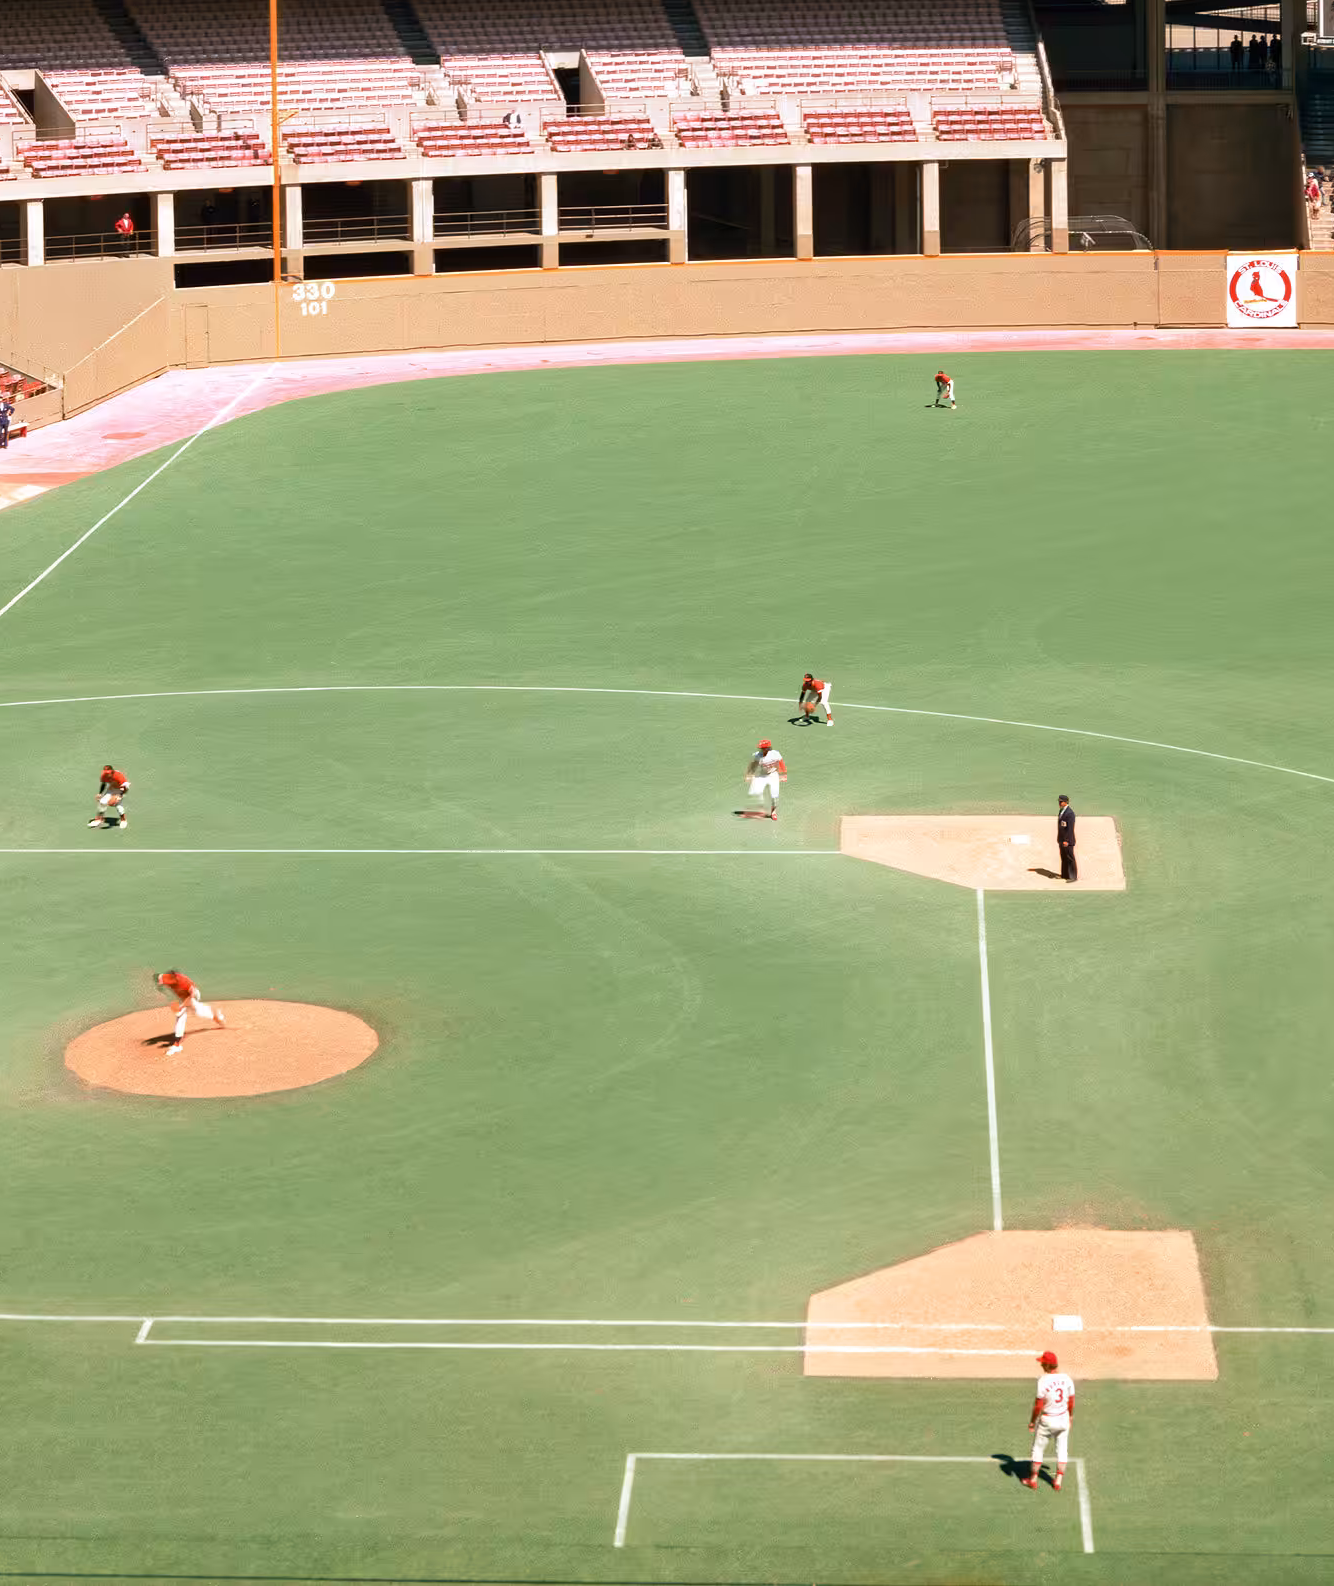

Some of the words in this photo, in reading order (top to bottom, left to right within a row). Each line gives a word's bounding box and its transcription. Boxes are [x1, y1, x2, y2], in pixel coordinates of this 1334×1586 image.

[292, 282, 335, 300] 330
[301, 301, 327, 316] 101
[1054, 1387, 1064, 1403] 3
